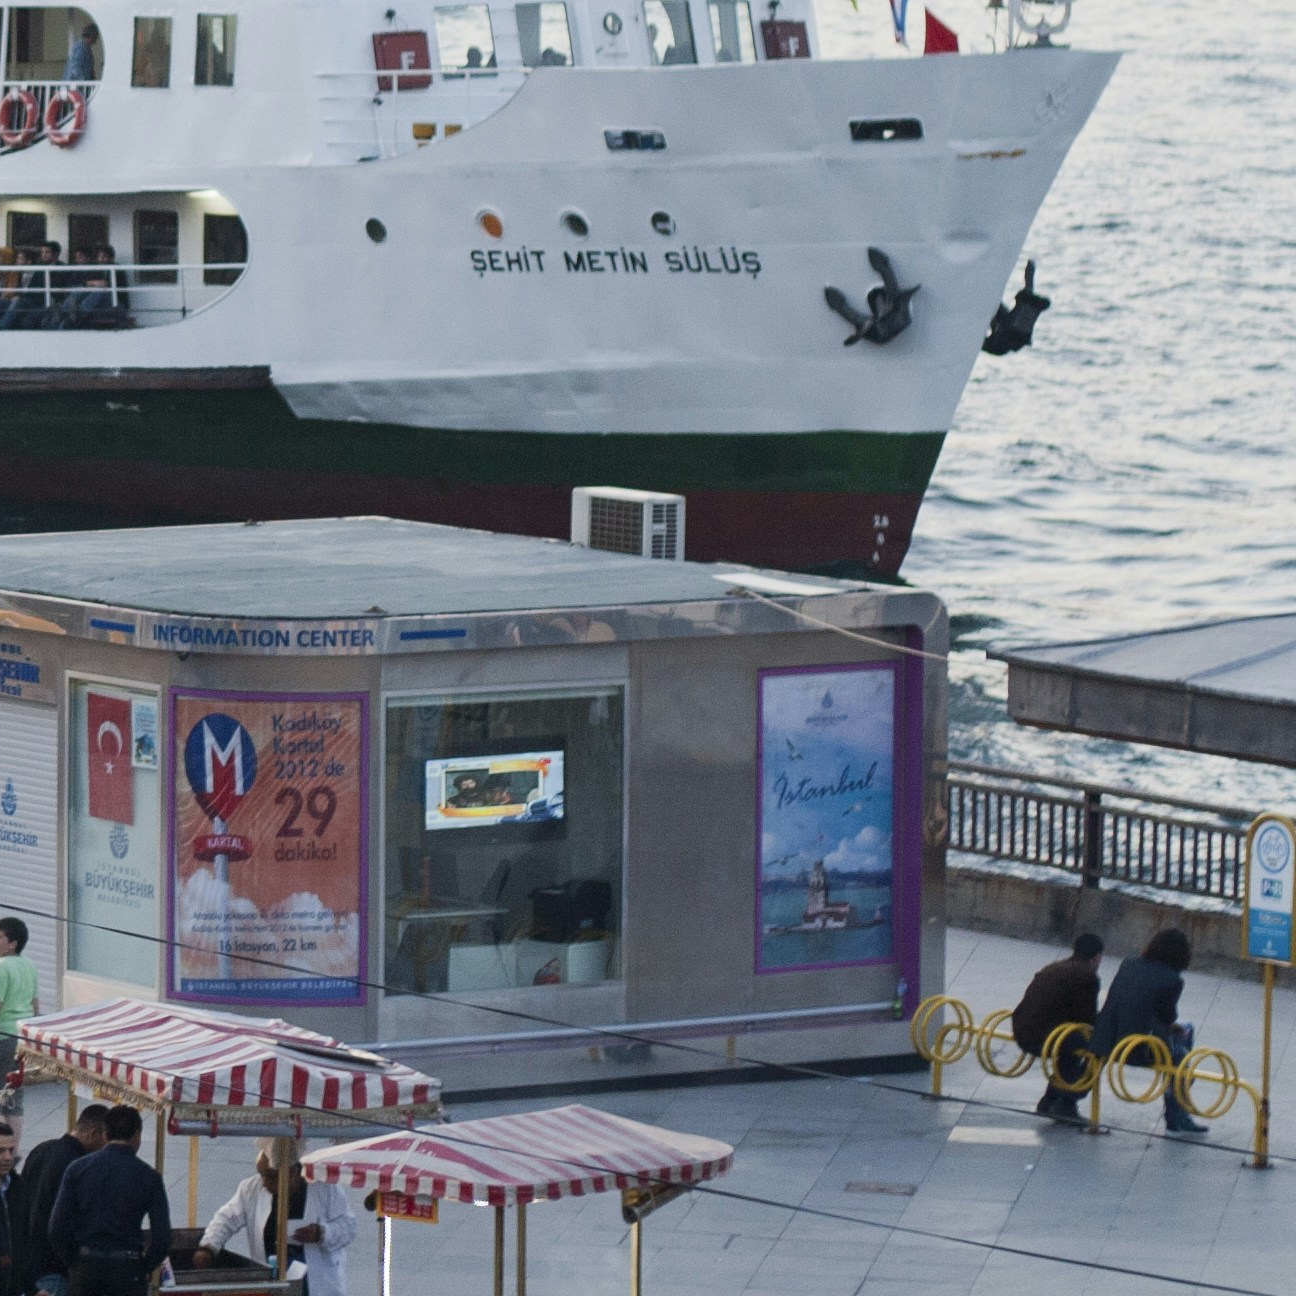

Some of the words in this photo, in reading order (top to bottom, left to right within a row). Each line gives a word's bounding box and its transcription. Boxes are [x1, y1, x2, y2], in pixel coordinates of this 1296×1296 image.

[470, 245, 545, 277] ŞEHİT
[564, 246, 649, 273] METİN
[664, 245, 762, 279] SÜLÜŞ
[153, 623, 290, 647] INFORMATION
[296, 629, 374, 647] CENTER
[202, 718, 245, 796] M
[275, 785, 338, 838] 29
[283, 938, 297, 951] 22
[301, 937, 317, 951] km
